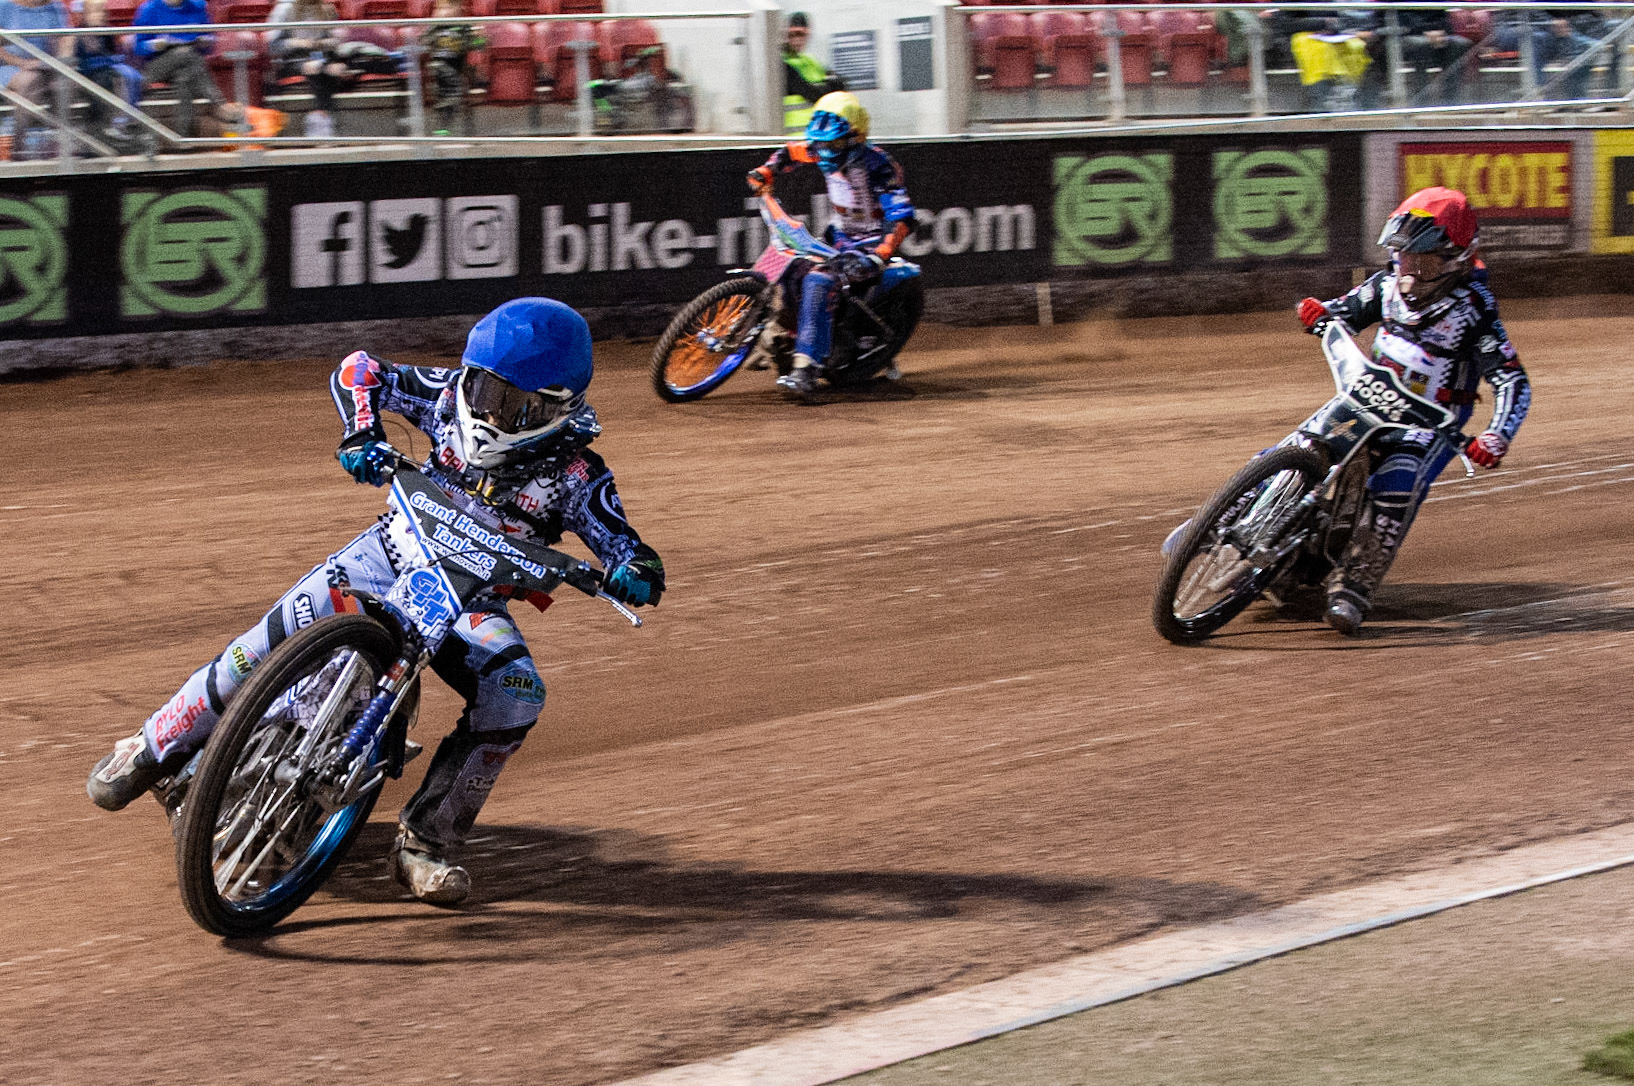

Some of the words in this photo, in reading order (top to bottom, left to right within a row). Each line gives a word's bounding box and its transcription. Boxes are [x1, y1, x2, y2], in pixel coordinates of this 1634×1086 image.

[1405, 152, 1569, 208] HYCOTE
[409, 490, 457, 526] Grant
[457, 513, 547, 579] Henderson
[433, 523, 497, 571] Tankers
[231, 645, 251, 676] SRM
[502, 675, 534, 690] SRM
[156, 696, 208, 751] Freight
